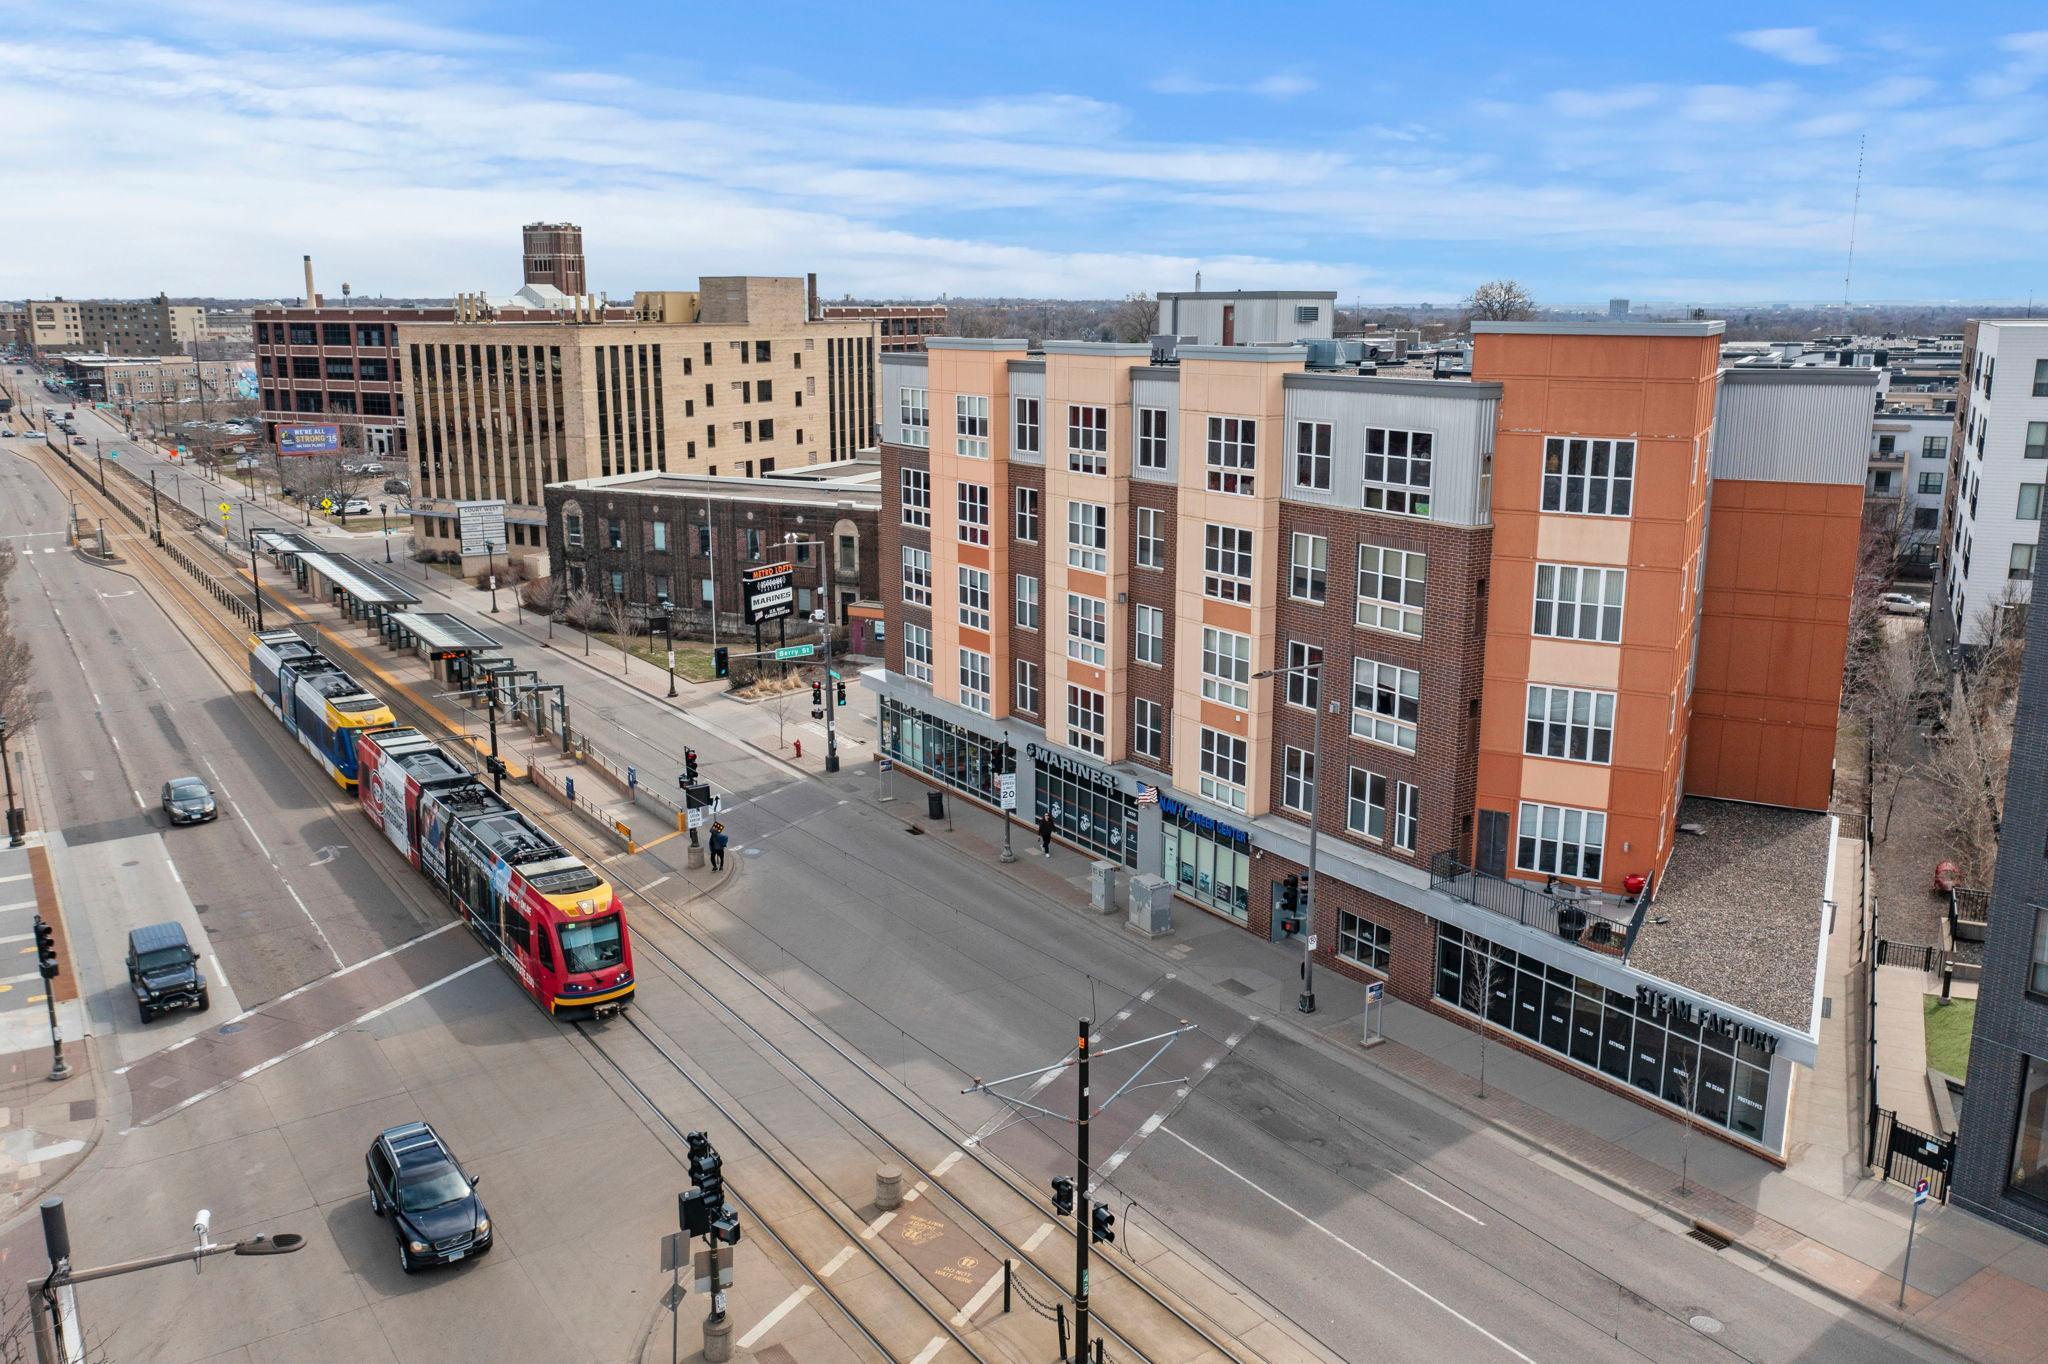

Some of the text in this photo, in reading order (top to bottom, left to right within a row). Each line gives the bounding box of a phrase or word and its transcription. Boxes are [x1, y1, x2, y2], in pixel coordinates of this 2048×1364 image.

[295, 435, 326, 443] STRONG
[752, 564, 793, 579] METRO LOFTS
[753, 591, 791, 606] MARINES
[780, 645, 810, 657] Berry St
[1034, 746, 1114, 789] MARINES
[1002, 790, 1015, 799] 20
[1159, 795, 1248, 844] NAVY CAREER CENTER
[1635, 984, 1780, 1055] STEAM FACTORY
[1608, 1039, 1626, 1051] ARTWORK
[1737, 1095, 1763, 1111] PROTOTYPES
